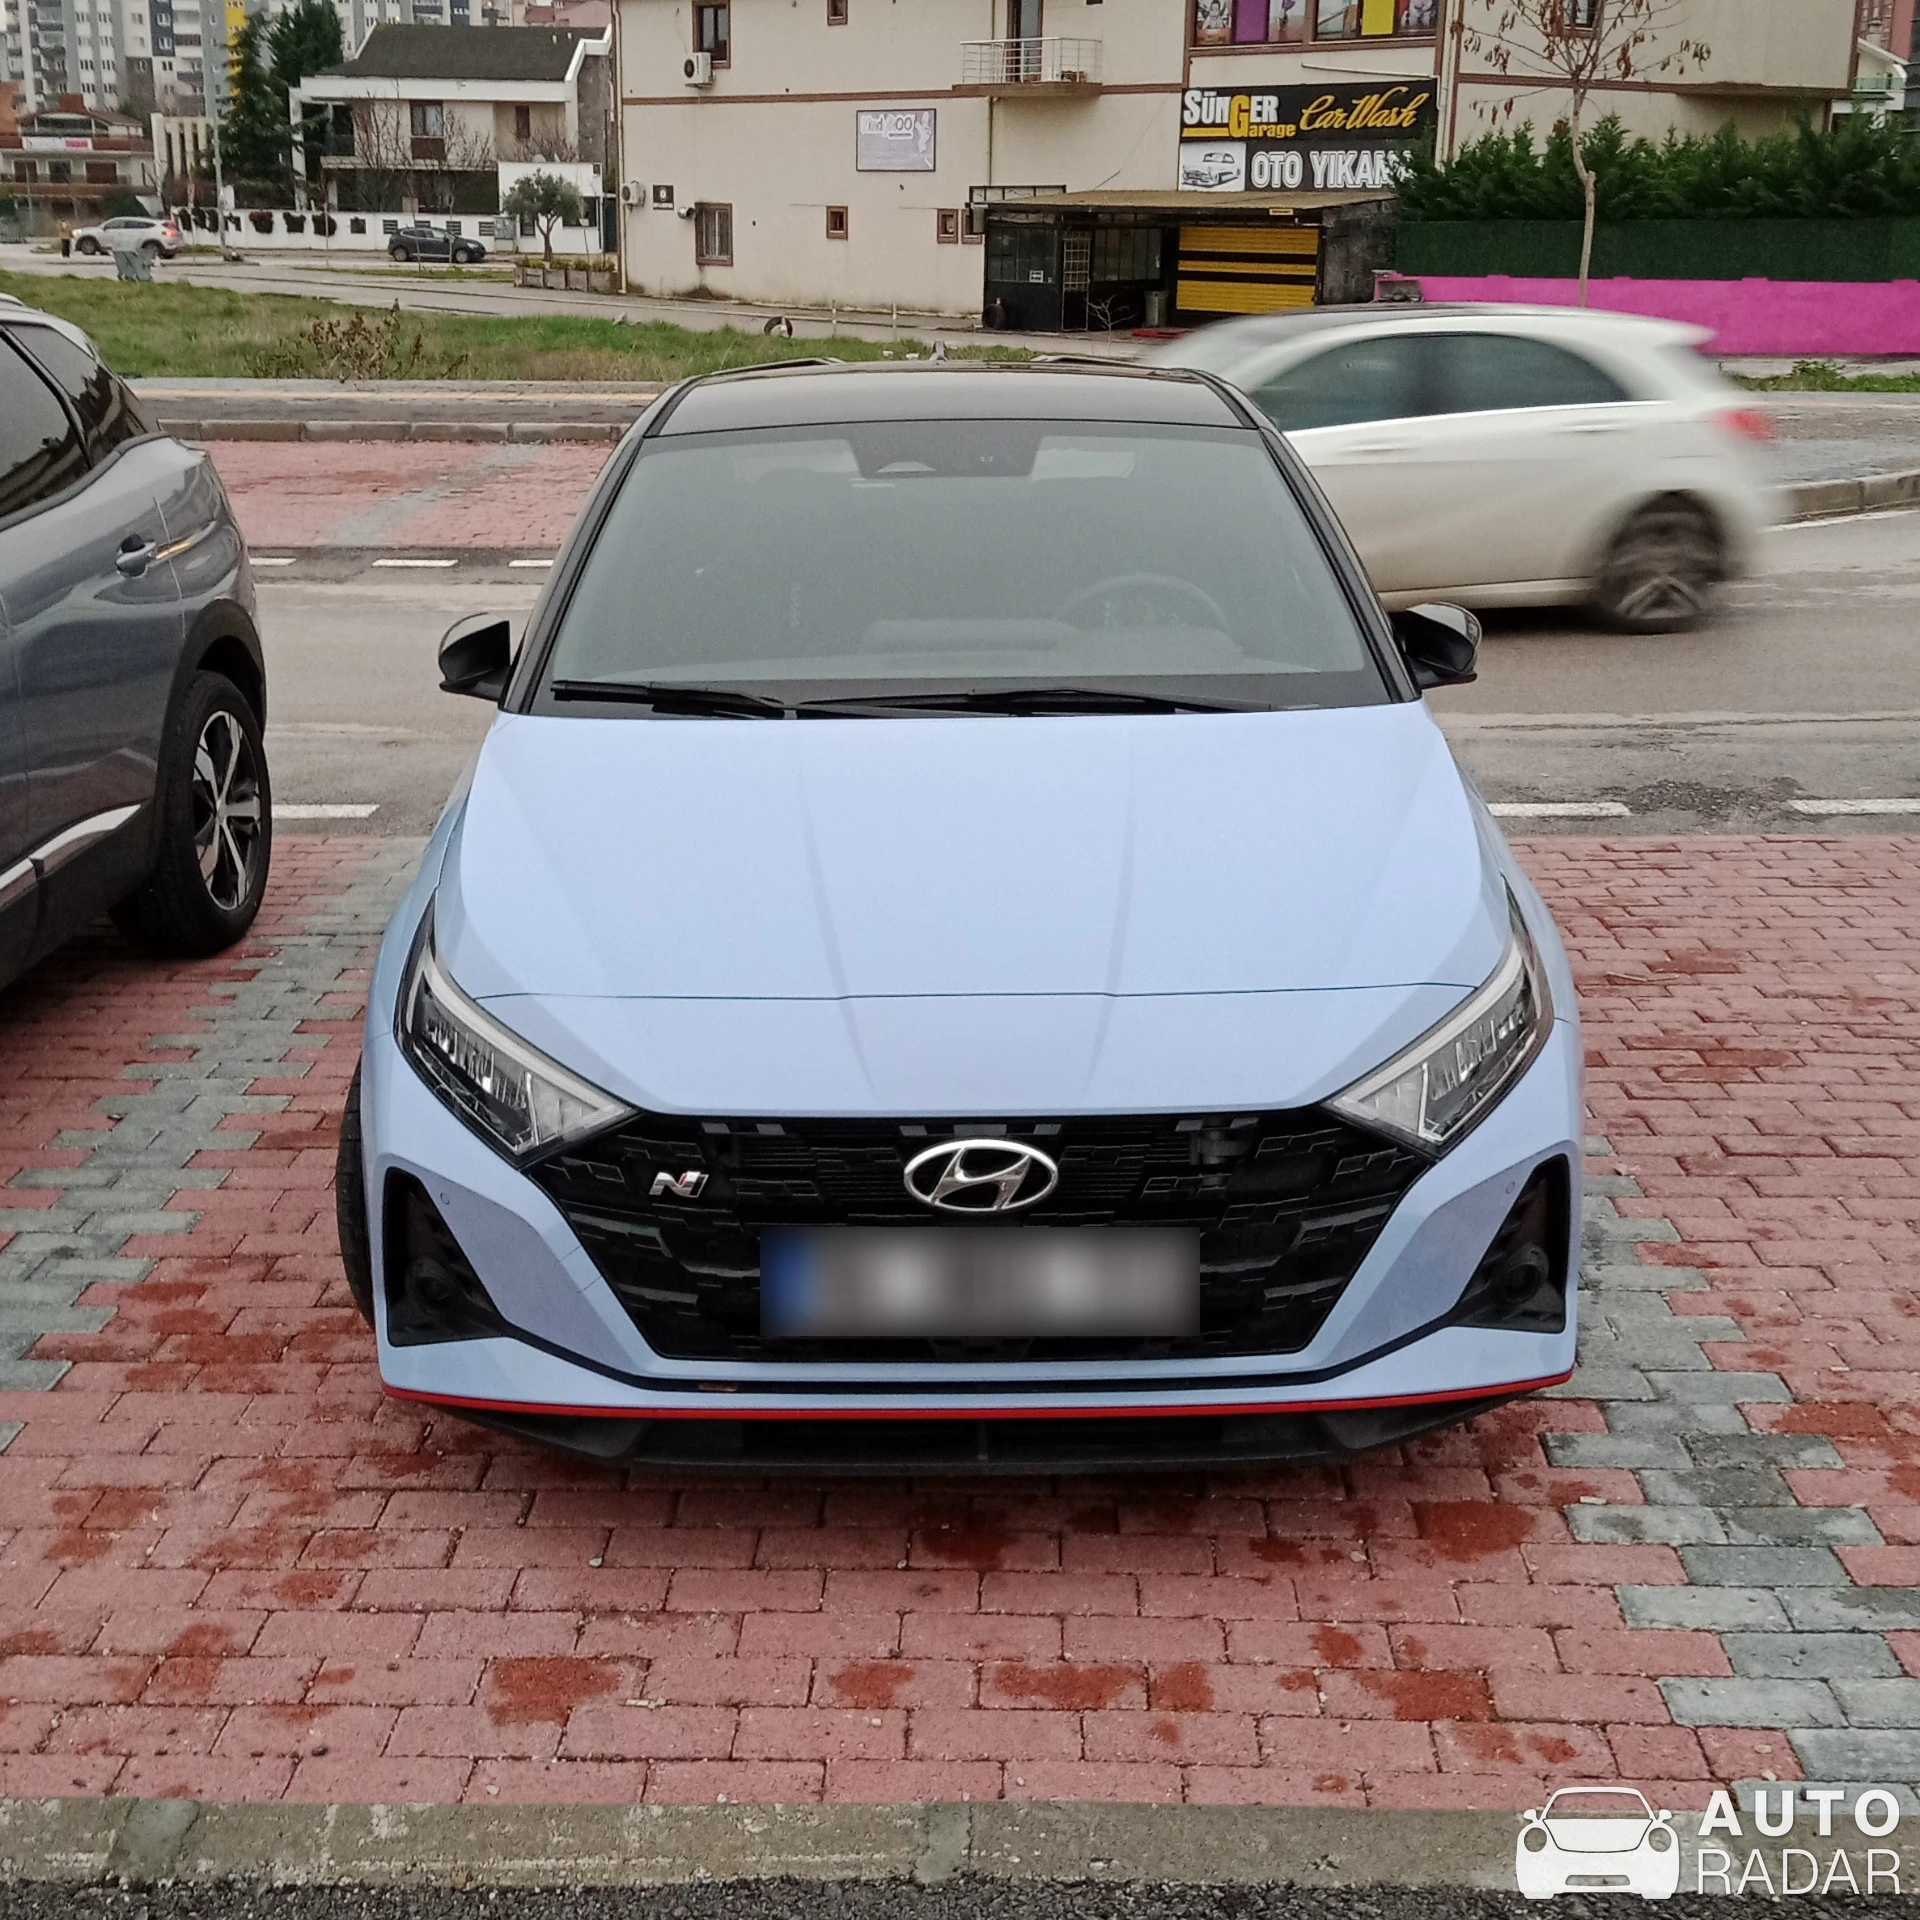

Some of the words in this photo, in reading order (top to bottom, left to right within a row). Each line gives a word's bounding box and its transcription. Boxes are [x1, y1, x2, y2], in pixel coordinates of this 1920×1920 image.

[1300, 94, 1348, 131] Car
[1348, 86, 1430, 130] Wash
[1251, 151, 1304, 188] OTO
